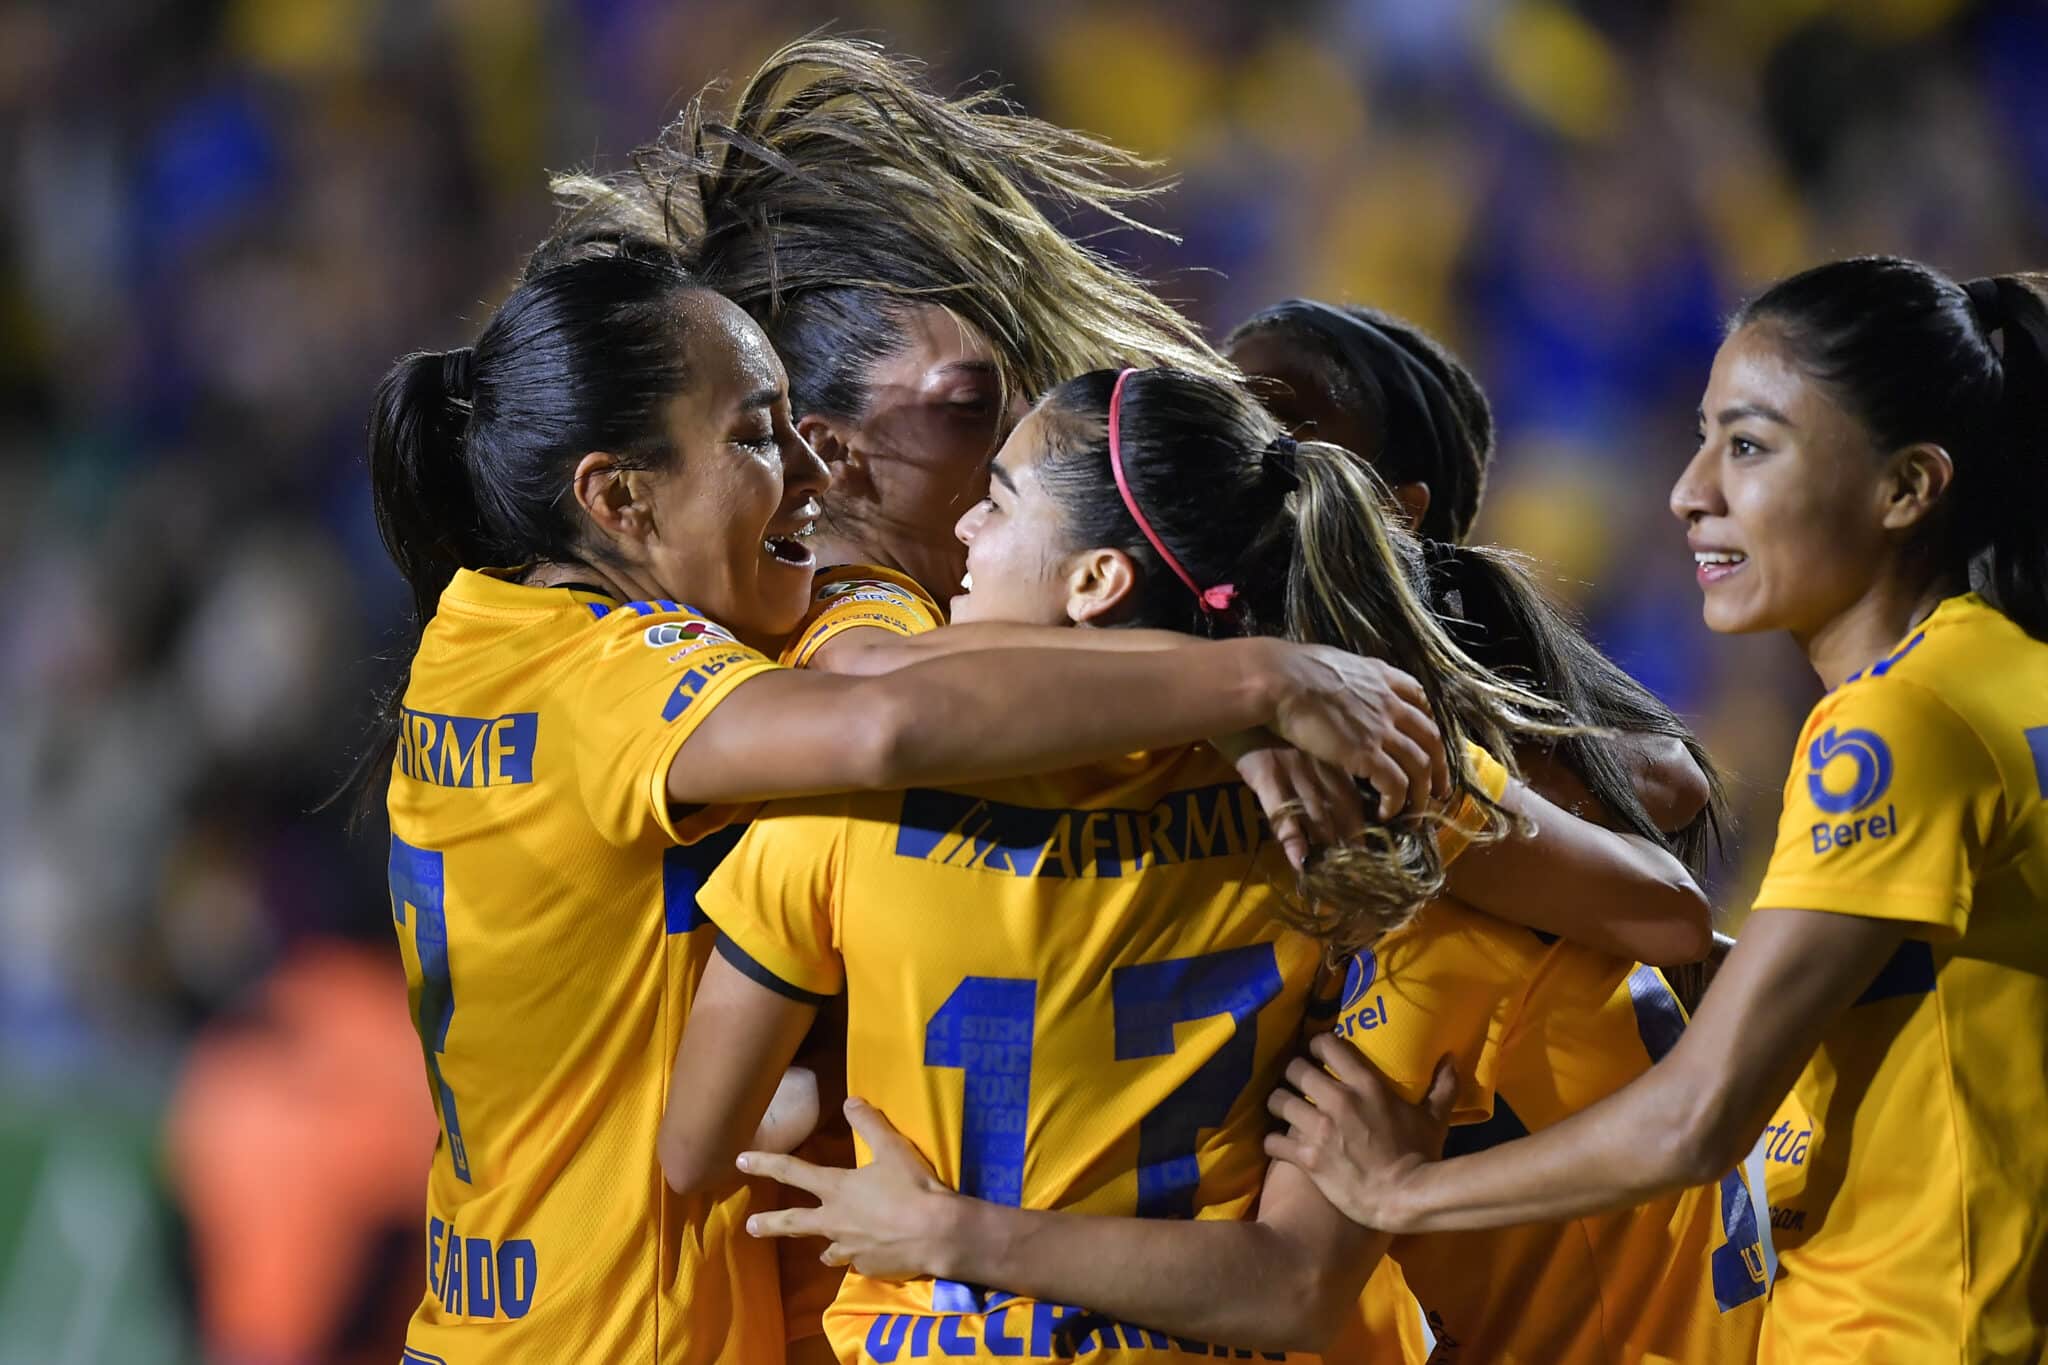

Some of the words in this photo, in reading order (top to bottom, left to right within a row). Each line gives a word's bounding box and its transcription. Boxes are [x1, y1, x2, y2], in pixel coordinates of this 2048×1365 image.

[397, 708, 516, 787] IRME
[1811, 803, 1897, 855] Berel
[1333, 995, 1388, 1037] erel
[925, 942, 1284, 1312] 17
